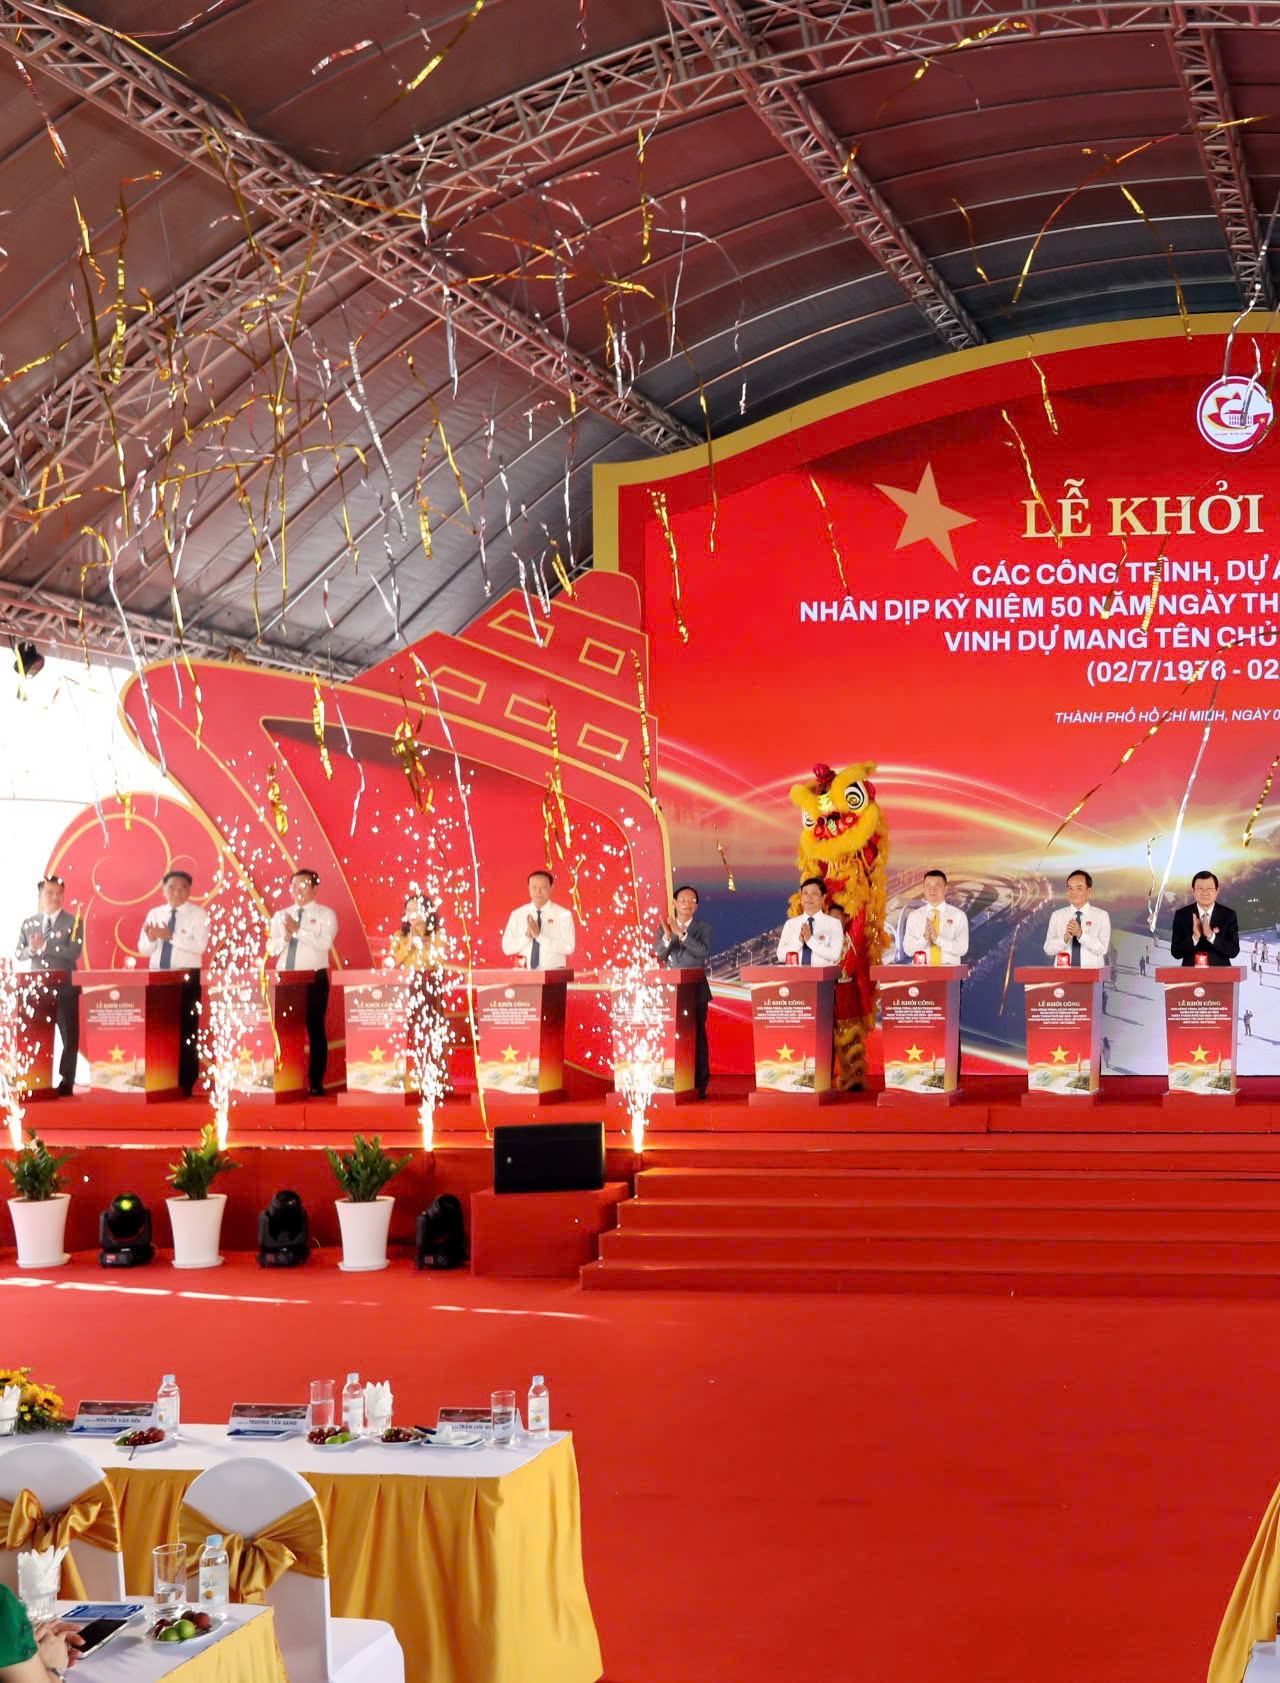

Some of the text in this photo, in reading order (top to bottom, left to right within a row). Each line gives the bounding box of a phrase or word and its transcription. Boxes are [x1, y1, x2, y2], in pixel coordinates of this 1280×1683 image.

[1021, 478, 1092, 538] LỄ
[1107, 480, 1265, 536] KHỞI
[973, 559, 1031, 586] CÁC
[1036, 559, 1119, 585] CÔNG
[1125, 556, 1220, 585] TRÌNH,
[1227, 554, 1269, 585] DỰ
[800, 596, 878, 622] NHÂN
[884, 599, 930, 625] DỊP
[934, 593, 970, 620] KỶ
[975, 592, 1044, 623] NIỆM
[1050, 596, 1083, 618] 50
[1089, 590, 1149, 617] NĂM
[1159, 587, 1237, 616] NGÀY
[944, 630, 1011, 652] VINH
[1018, 624, 1060, 655] DỰ
[1063, 629, 1149, 650] MANG
[1154, 622, 1211, 649] TÊN
[1216, 620, 1277, 647] CHỦ
[1086, 658, 1227, 687] (02/7/1976
[1055, 709, 1103, 724] THÀNH
[1105, 706, 1136, 723] PHỐ
[1138, 707, 1160, 722] HỒ
[1162, 708, 1187, 722] CHÍ
[1189, 709, 1228, 723] MINH,
[1231, 706, 1271, 721] NGÀY
